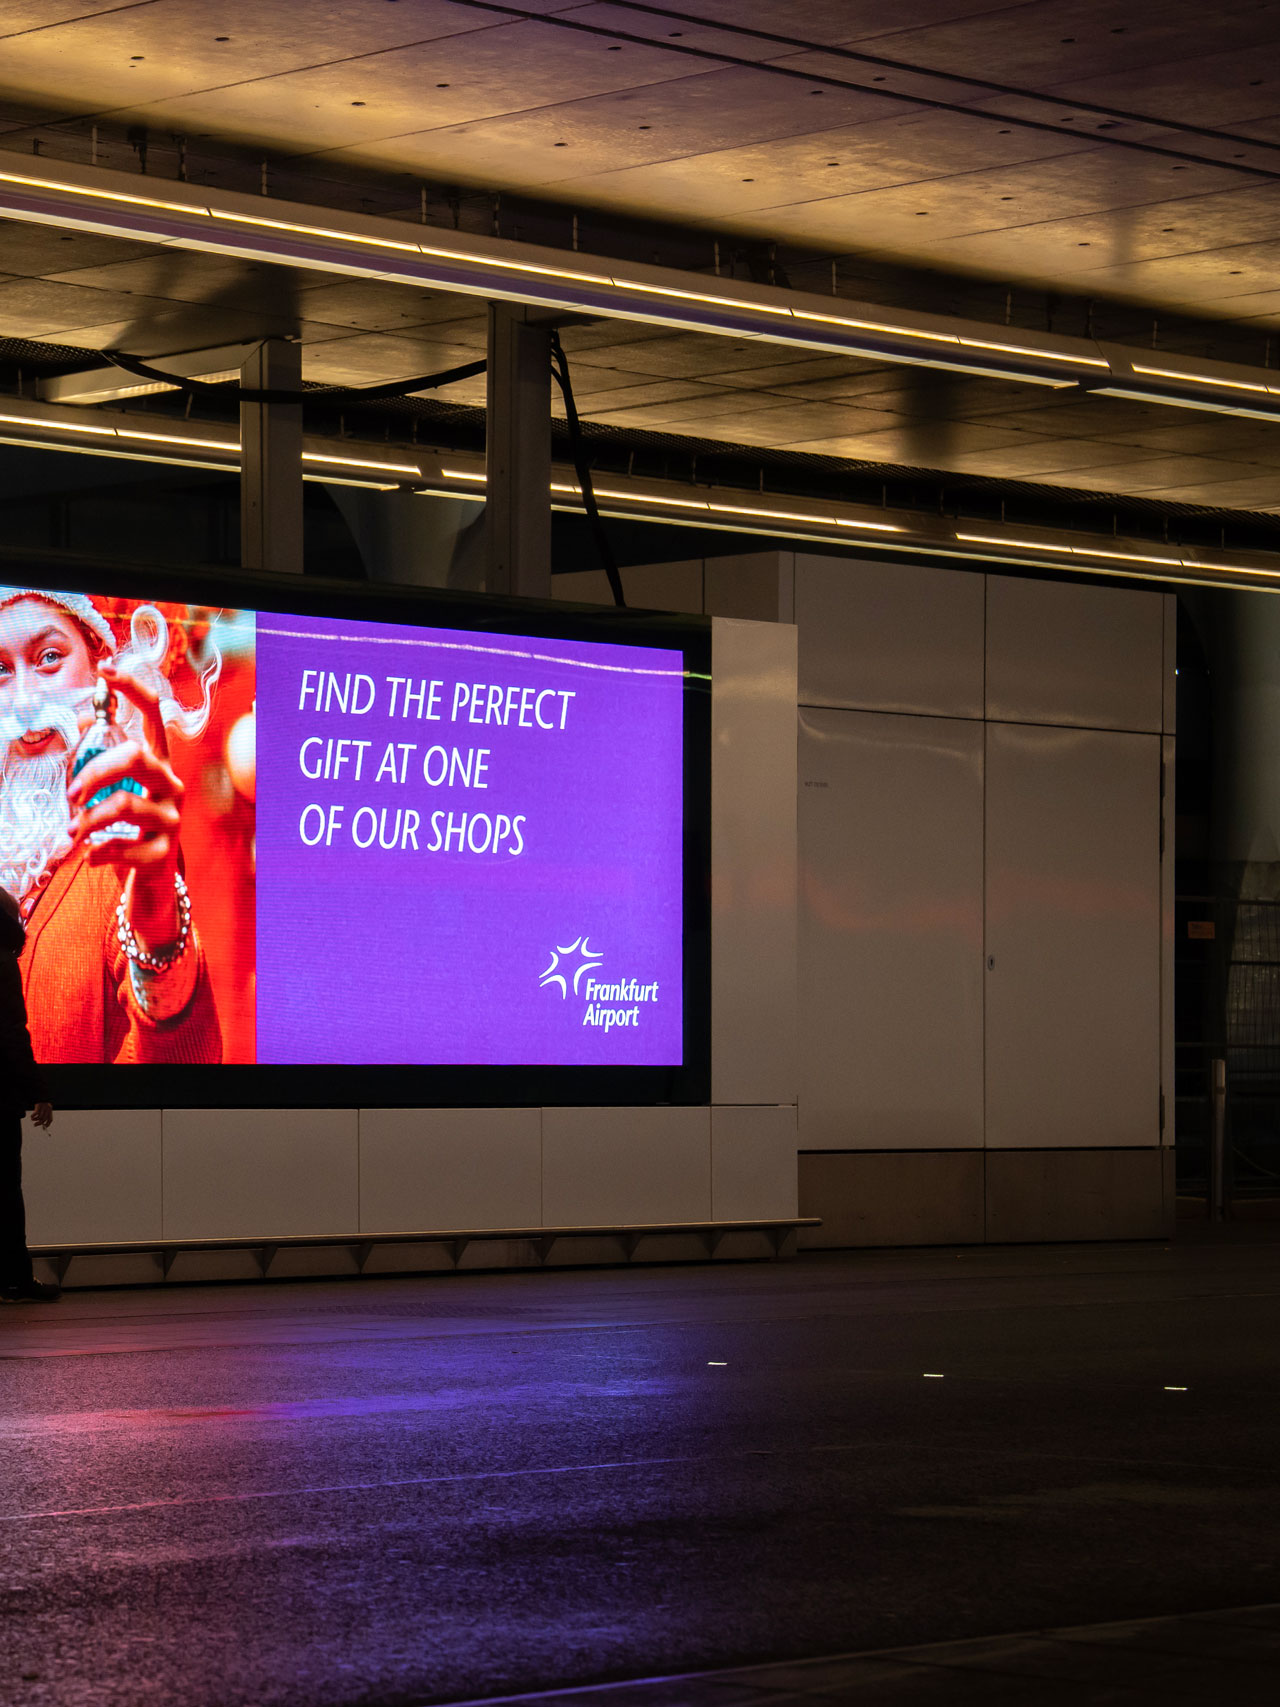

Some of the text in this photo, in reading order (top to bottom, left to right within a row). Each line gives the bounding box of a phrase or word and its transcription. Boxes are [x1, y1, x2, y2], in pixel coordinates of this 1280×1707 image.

[298, 669, 576, 730] FIND THE PERFECT
[298, 736, 491, 789] GIFT AT ONE
[298, 803, 527, 856] OF OUR SHOPS
[585, 977, 659, 1002] Frankfurt
[582, 1002, 640, 1033] Airport
